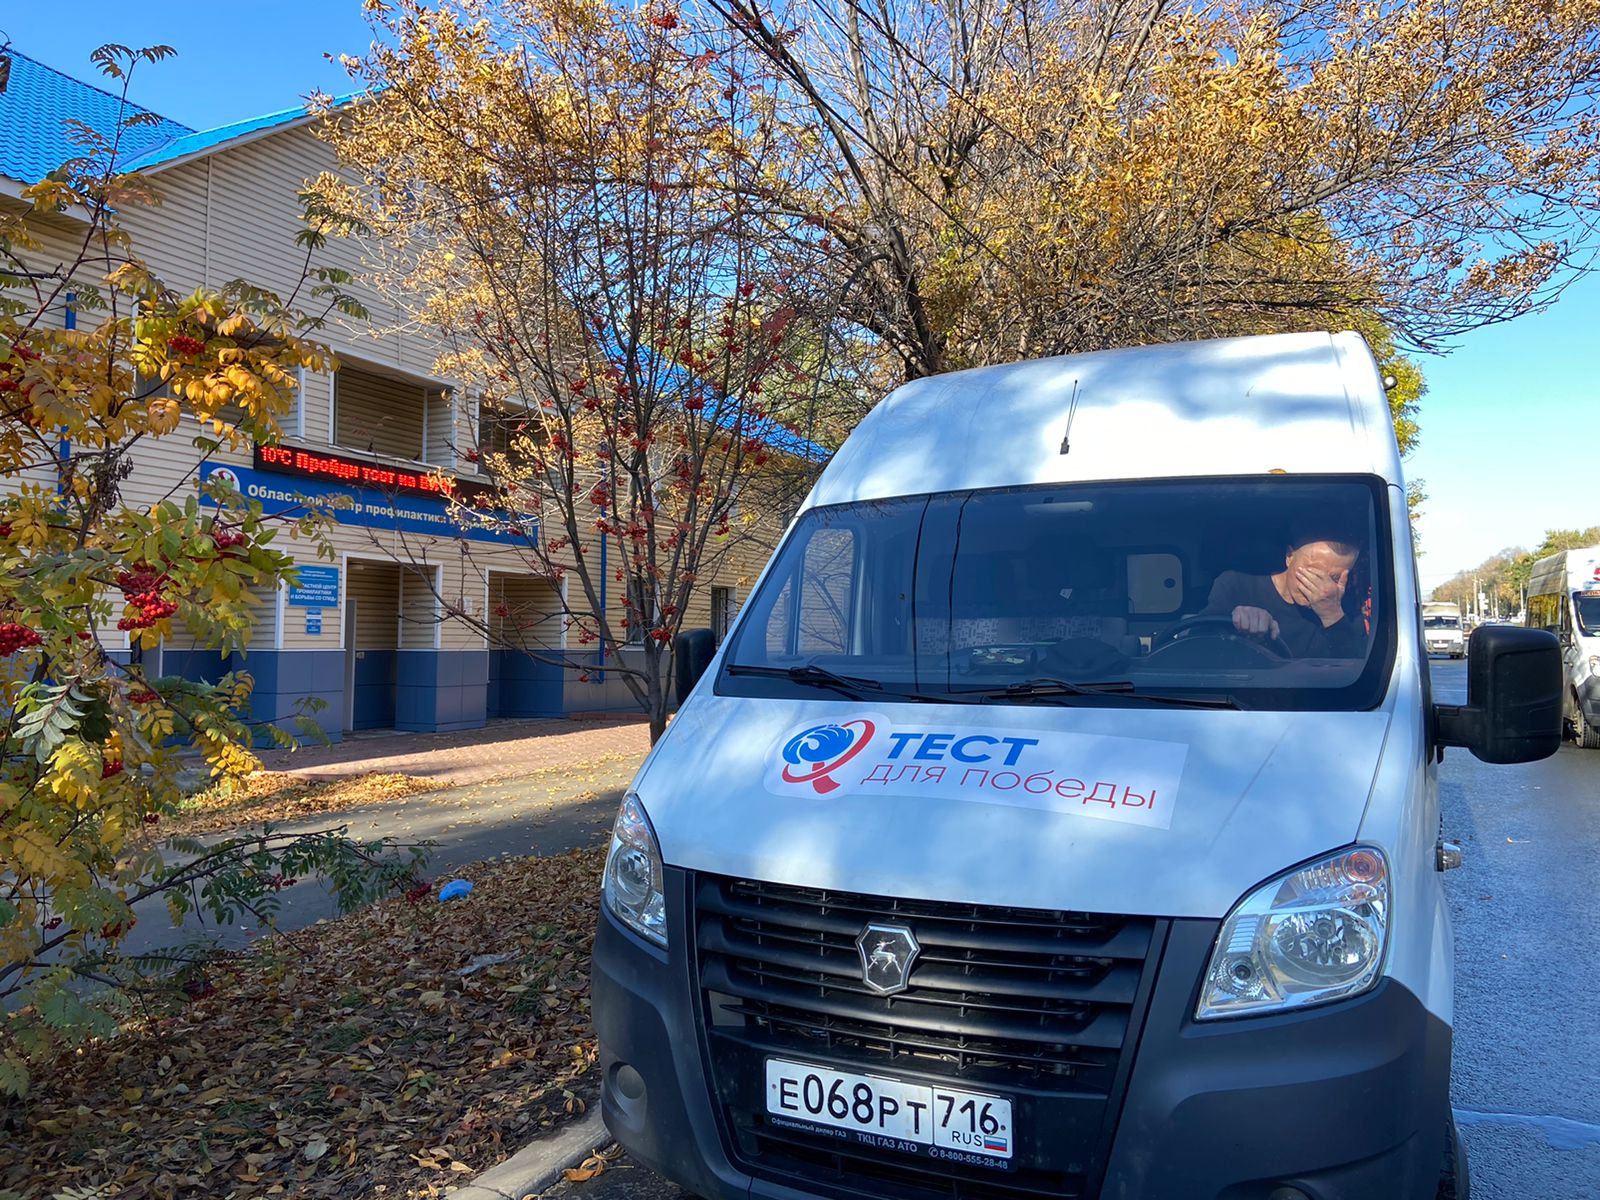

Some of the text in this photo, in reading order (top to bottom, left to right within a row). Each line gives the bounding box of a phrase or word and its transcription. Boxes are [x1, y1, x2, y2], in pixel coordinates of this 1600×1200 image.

[296, 453, 359, 479] Пройди
[398, 474, 416, 488] на
[887, 732, 1039, 766] ТЕСТ
[860, 764, 1157, 809] для победы
[937, 1094, 999, 1135] 716
[771, 1117, 815, 1131] Официальный
[835, 1129, 847, 1138] ГАЗ
[857, 1133, 876, 1147] ТКЦ
[878, 1137, 896, 1149] ГАЗ
[898, 1141, 918, 1153] АТО
[952, 1131, 982, 1147] RUS
